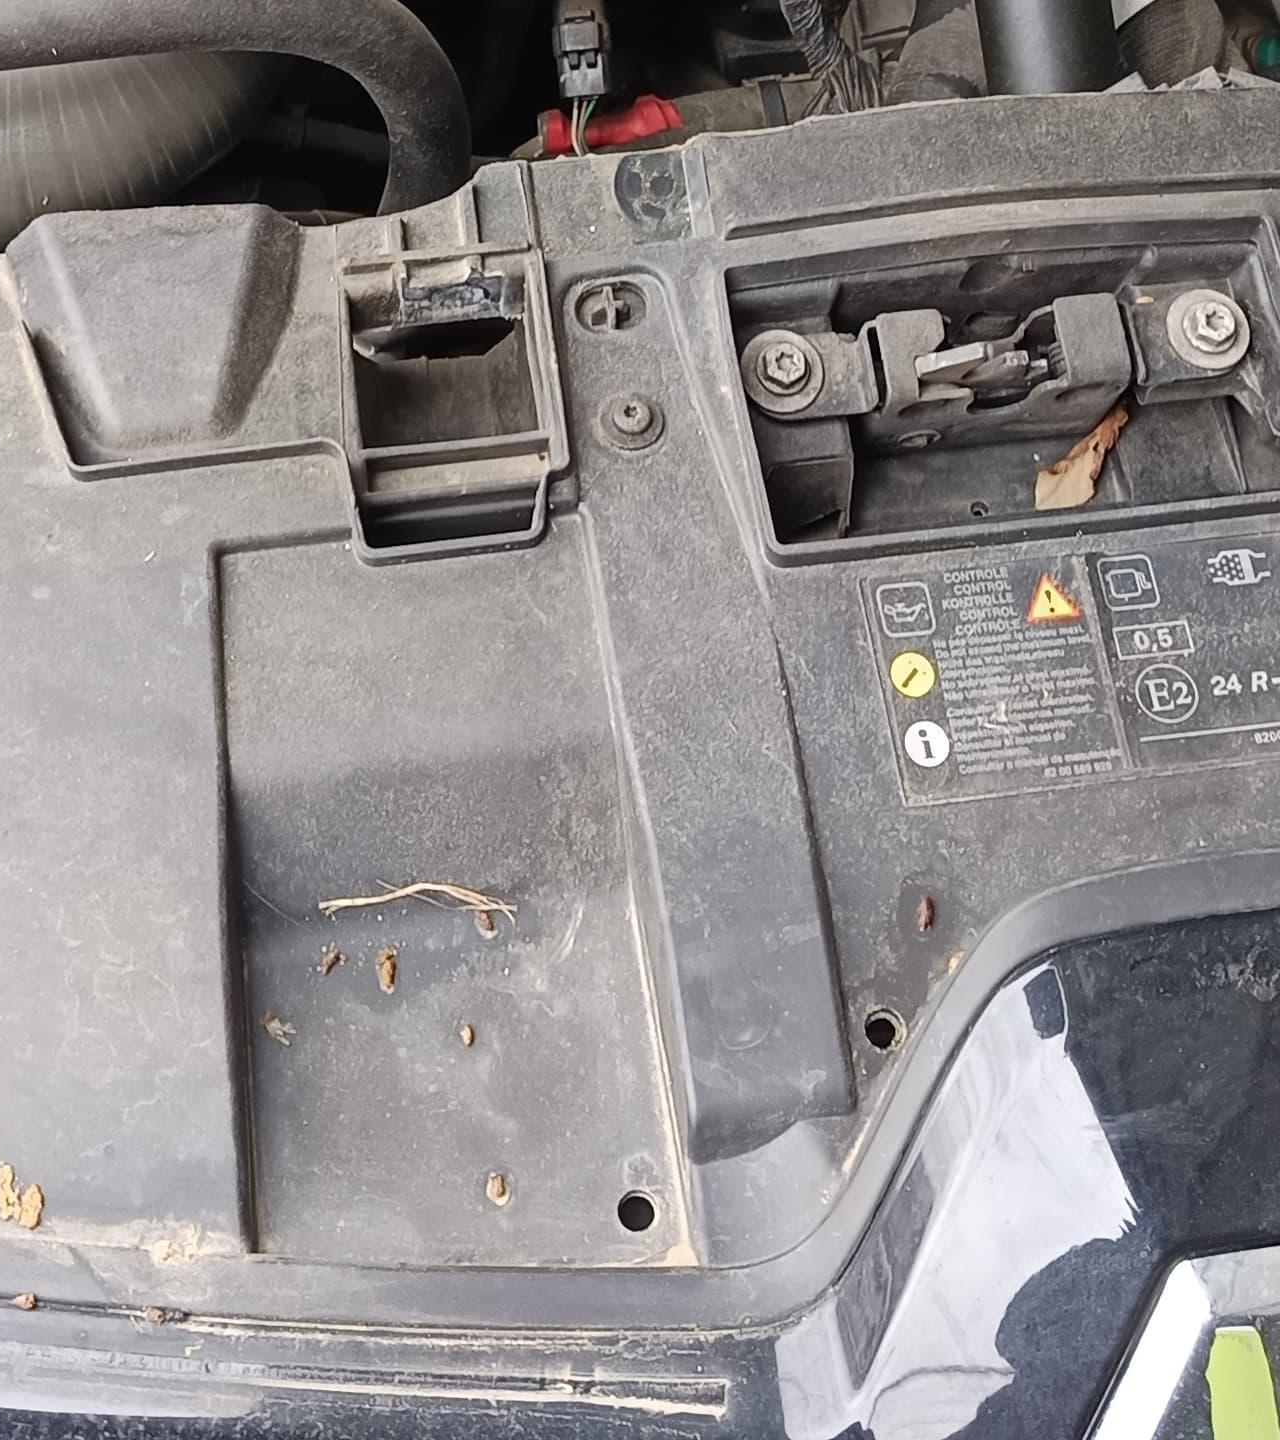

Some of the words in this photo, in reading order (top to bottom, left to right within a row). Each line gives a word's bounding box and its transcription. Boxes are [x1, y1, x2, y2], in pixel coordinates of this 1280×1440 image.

[954, 580, 1012, 595] CONTROL
[1133, 628, 1173, 652] 0,5
[1144, 678, 1192, 712] E2
[1209, 675, 1243, 698] 24
